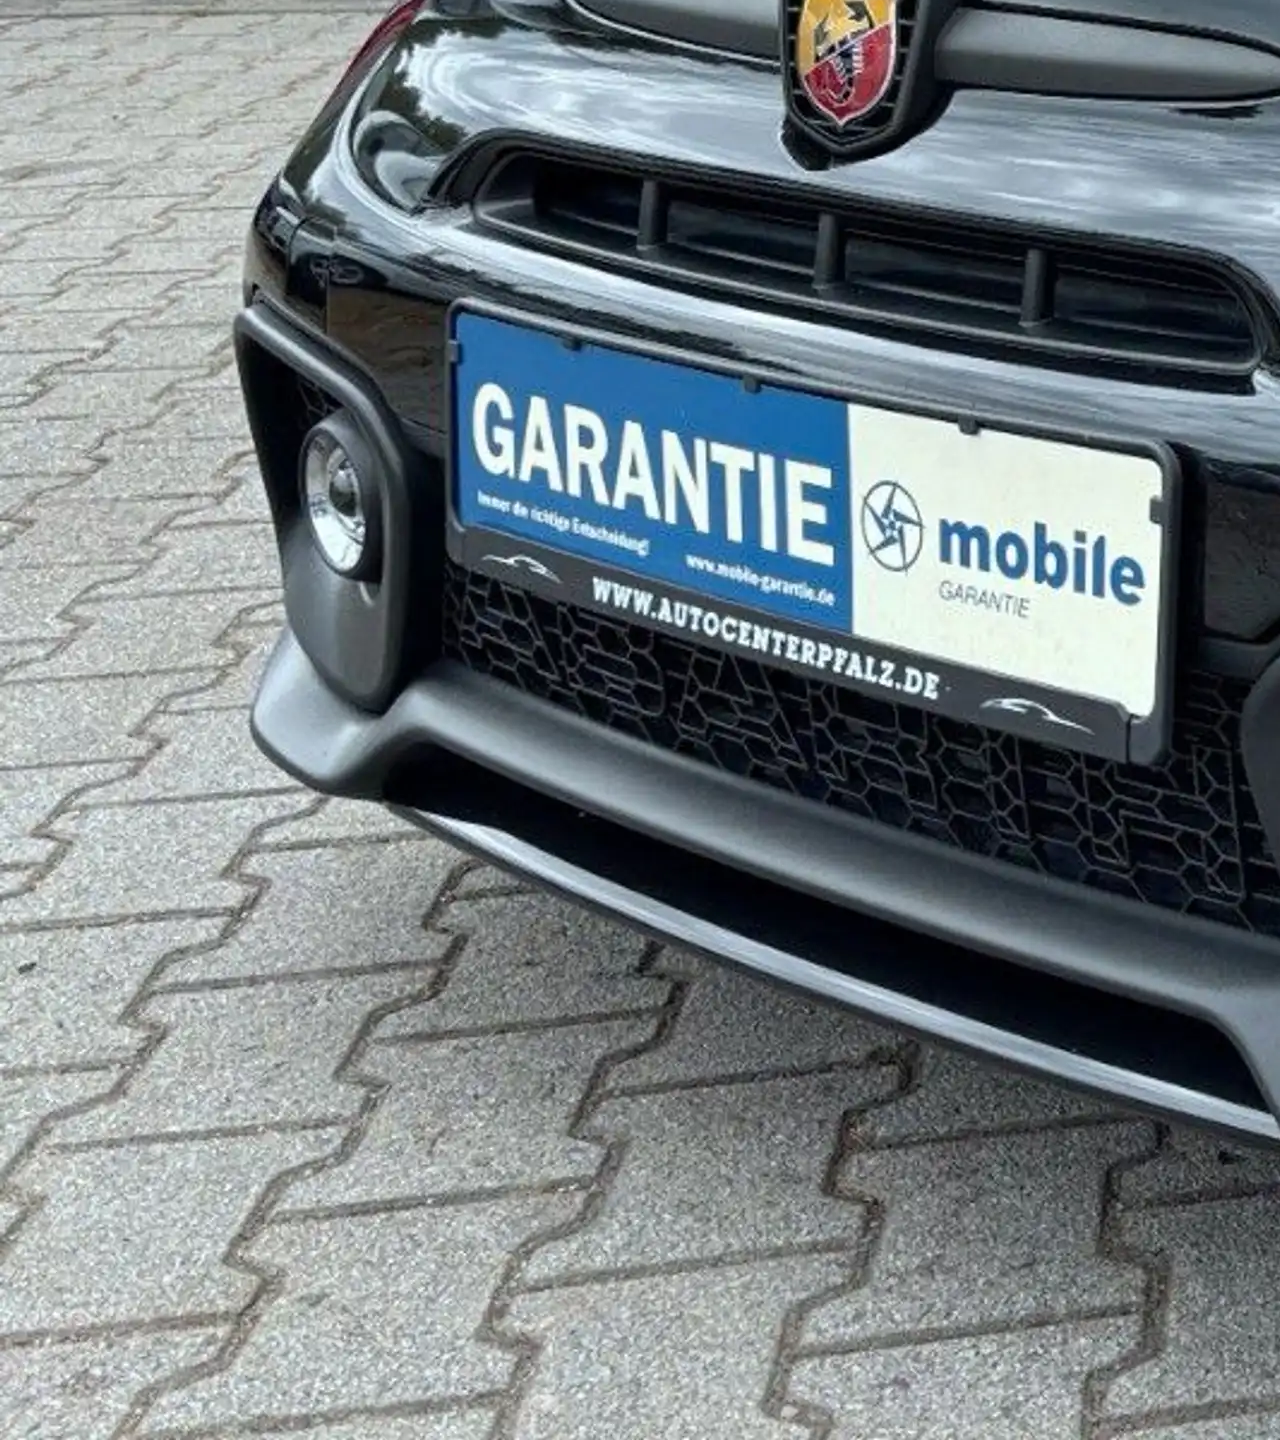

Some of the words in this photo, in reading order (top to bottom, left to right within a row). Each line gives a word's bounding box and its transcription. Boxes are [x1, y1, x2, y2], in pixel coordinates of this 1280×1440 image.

[472, 381, 835, 567] GARANTIE
[685, 554, 836, 607] www.mobile-garantie.de
[938, 517, 1146, 606] mobile
[938, 579, 1031, 620] GARANTIE
[591, 574, 940, 701] WWW.AUTOCENTERPFALZ.DE
